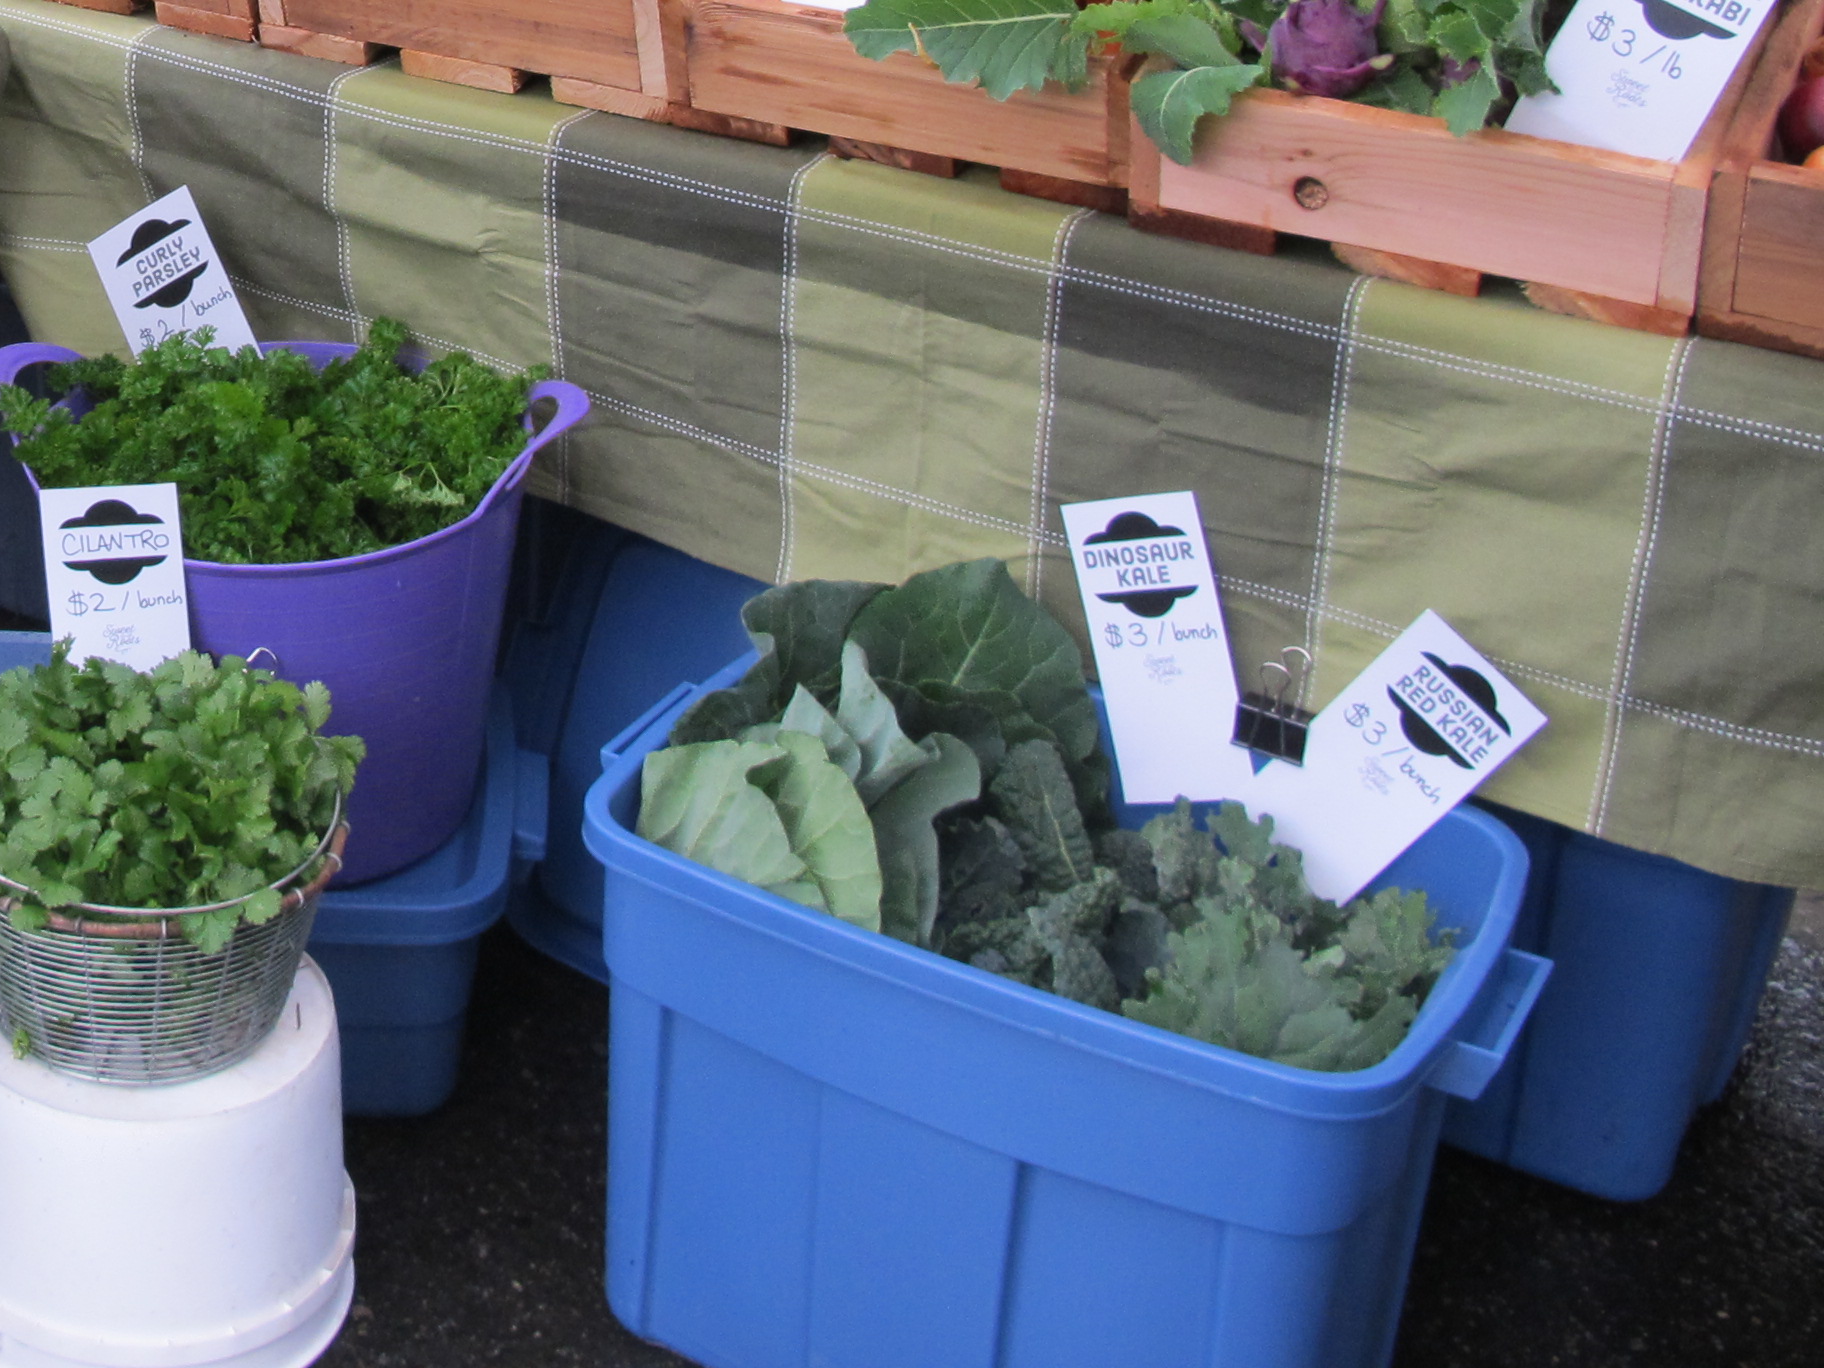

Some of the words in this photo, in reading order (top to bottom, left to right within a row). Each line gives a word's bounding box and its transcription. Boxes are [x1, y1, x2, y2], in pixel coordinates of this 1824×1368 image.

[132, 246, 201, 298] PARSLEY
[135, 236, 183, 275] CURLY
[62, 529, 170, 556] CILANTRO
[1082, 541, 1195, 569] DINOSAUR
[1116, 565, 1171, 587] KALE
[1396, 674, 1437, 714] RED
[1436, 711, 1489, 764] KALE
[1412, 663, 1500, 747] RUSSIAN
